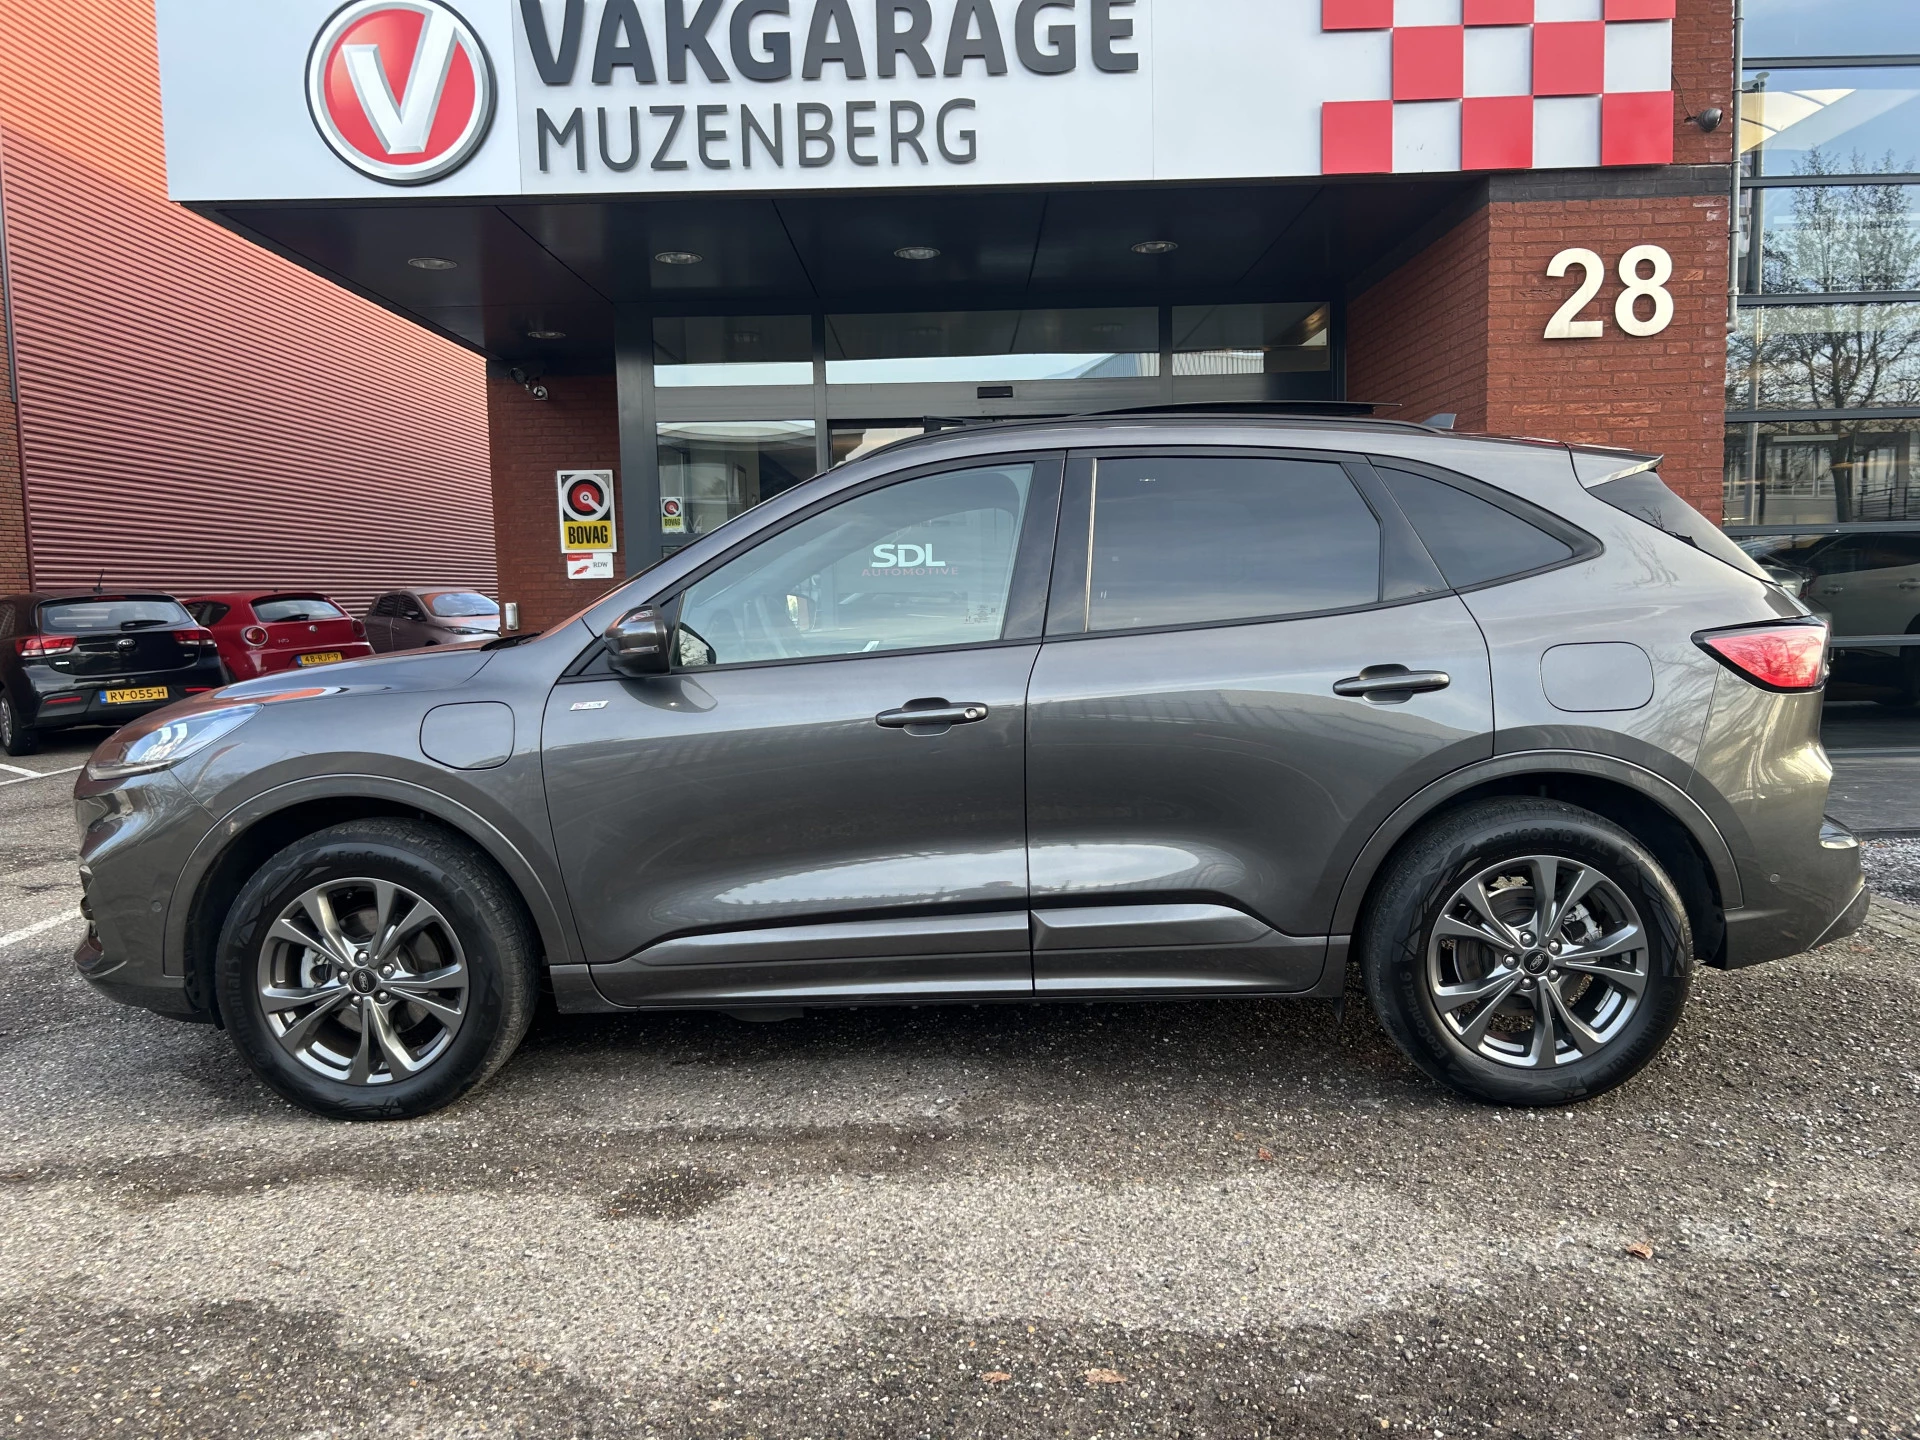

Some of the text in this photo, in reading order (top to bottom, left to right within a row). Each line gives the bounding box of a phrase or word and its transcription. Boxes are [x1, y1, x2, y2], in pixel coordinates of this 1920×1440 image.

[518, 0, 1139, 84] VAKGARAGE
[536, 98, 977, 172] MUZENBERG
[1543, 244, 1674, 339] 28
[664, 518, 681, 527] BOVAG
[568, 525, 608, 544] BOVAG
[871, 543, 946, 567] SDL
[861, 567, 960, 577] AUTOMOTIVE
[304, 653, 339, 663] 48-RJF-9
[110, 688, 165, 701] RV-055-H
